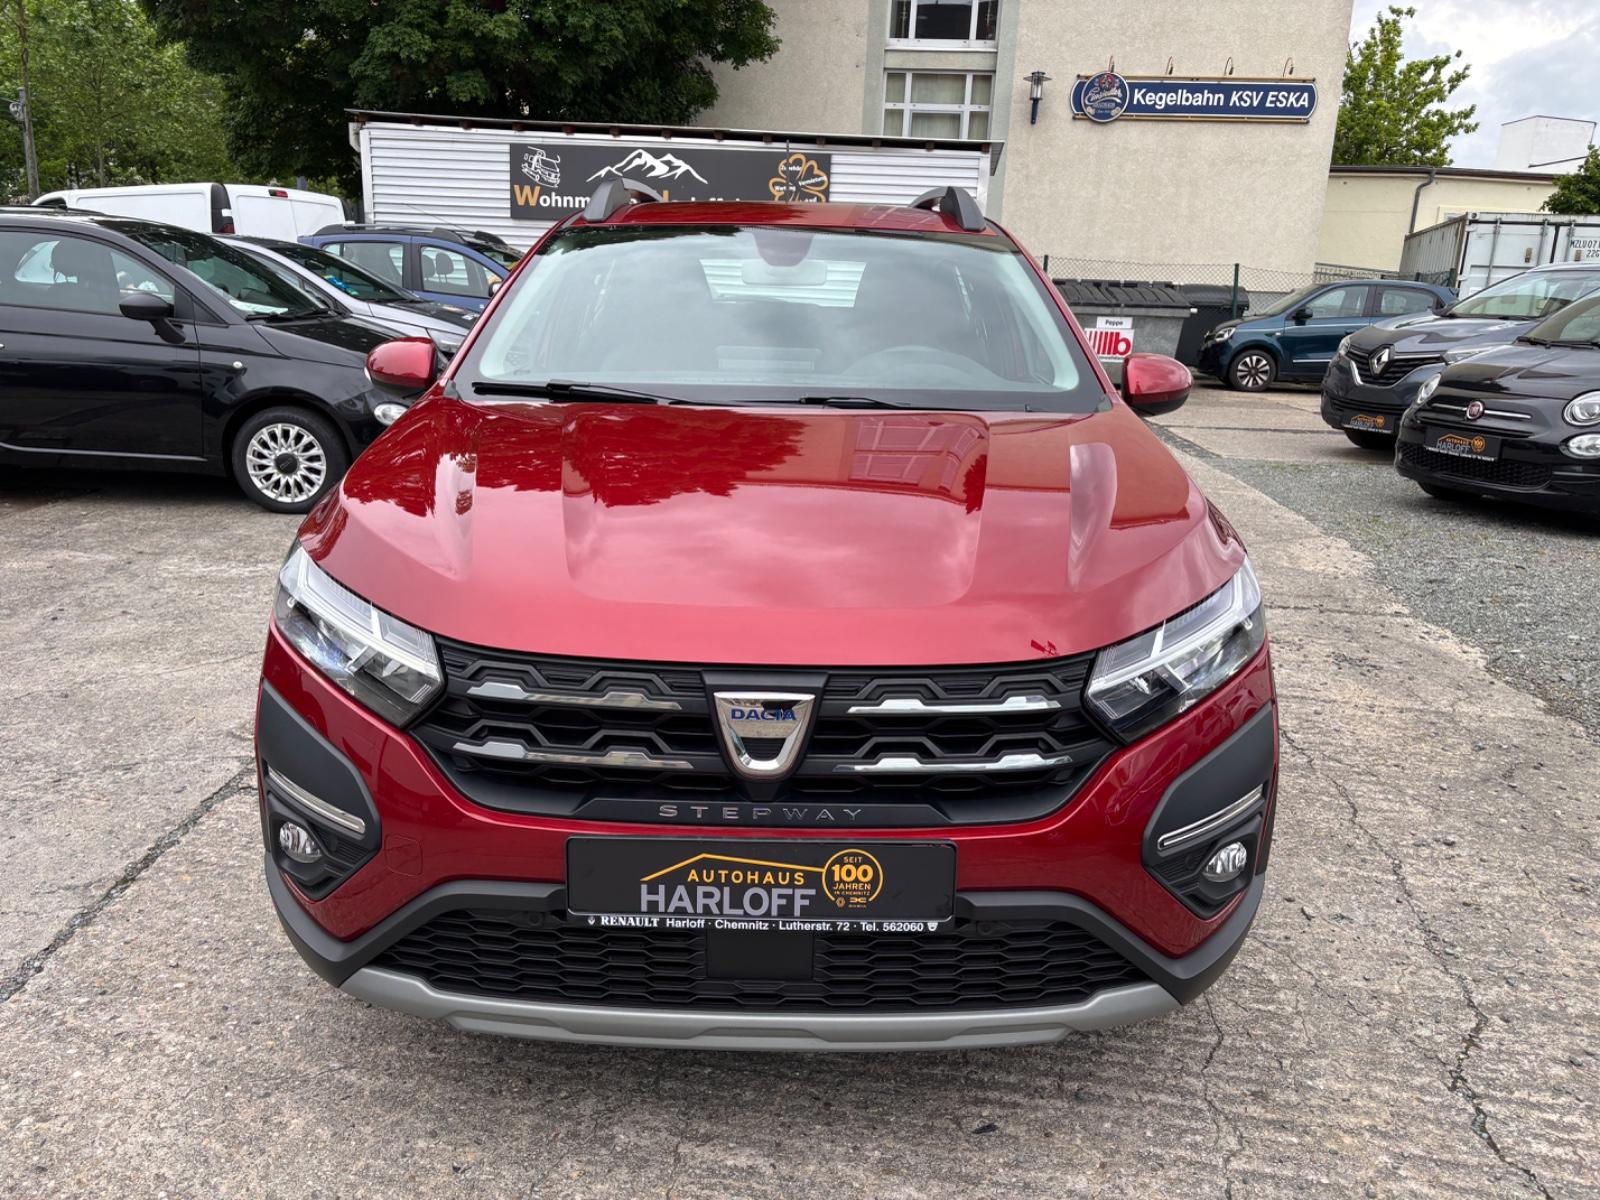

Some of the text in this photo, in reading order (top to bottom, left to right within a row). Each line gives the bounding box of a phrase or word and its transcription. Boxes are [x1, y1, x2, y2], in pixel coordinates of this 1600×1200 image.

[1133, 89, 1309, 109] Kegelbahn KSV ESKA
[513, 184, 592, 208] Wohnm
[1436, 440, 1471, 454] HARLOFF
[731, 708, 796, 721] DACIA
[659, 805, 862, 821] STEPWAY
[843, 856, 863, 864] SEIT
[687, 869, 805, 885] AUTOHAUS
[831, 864, 874, 882] 100
[833, 882, 872, 891] JAHREN
[640, 884, 816, 917] HARLOFF
[601, 916, 924, 932] RENAULT Harloff Chemnitz Lutherstr. 72 Tel. 562060
